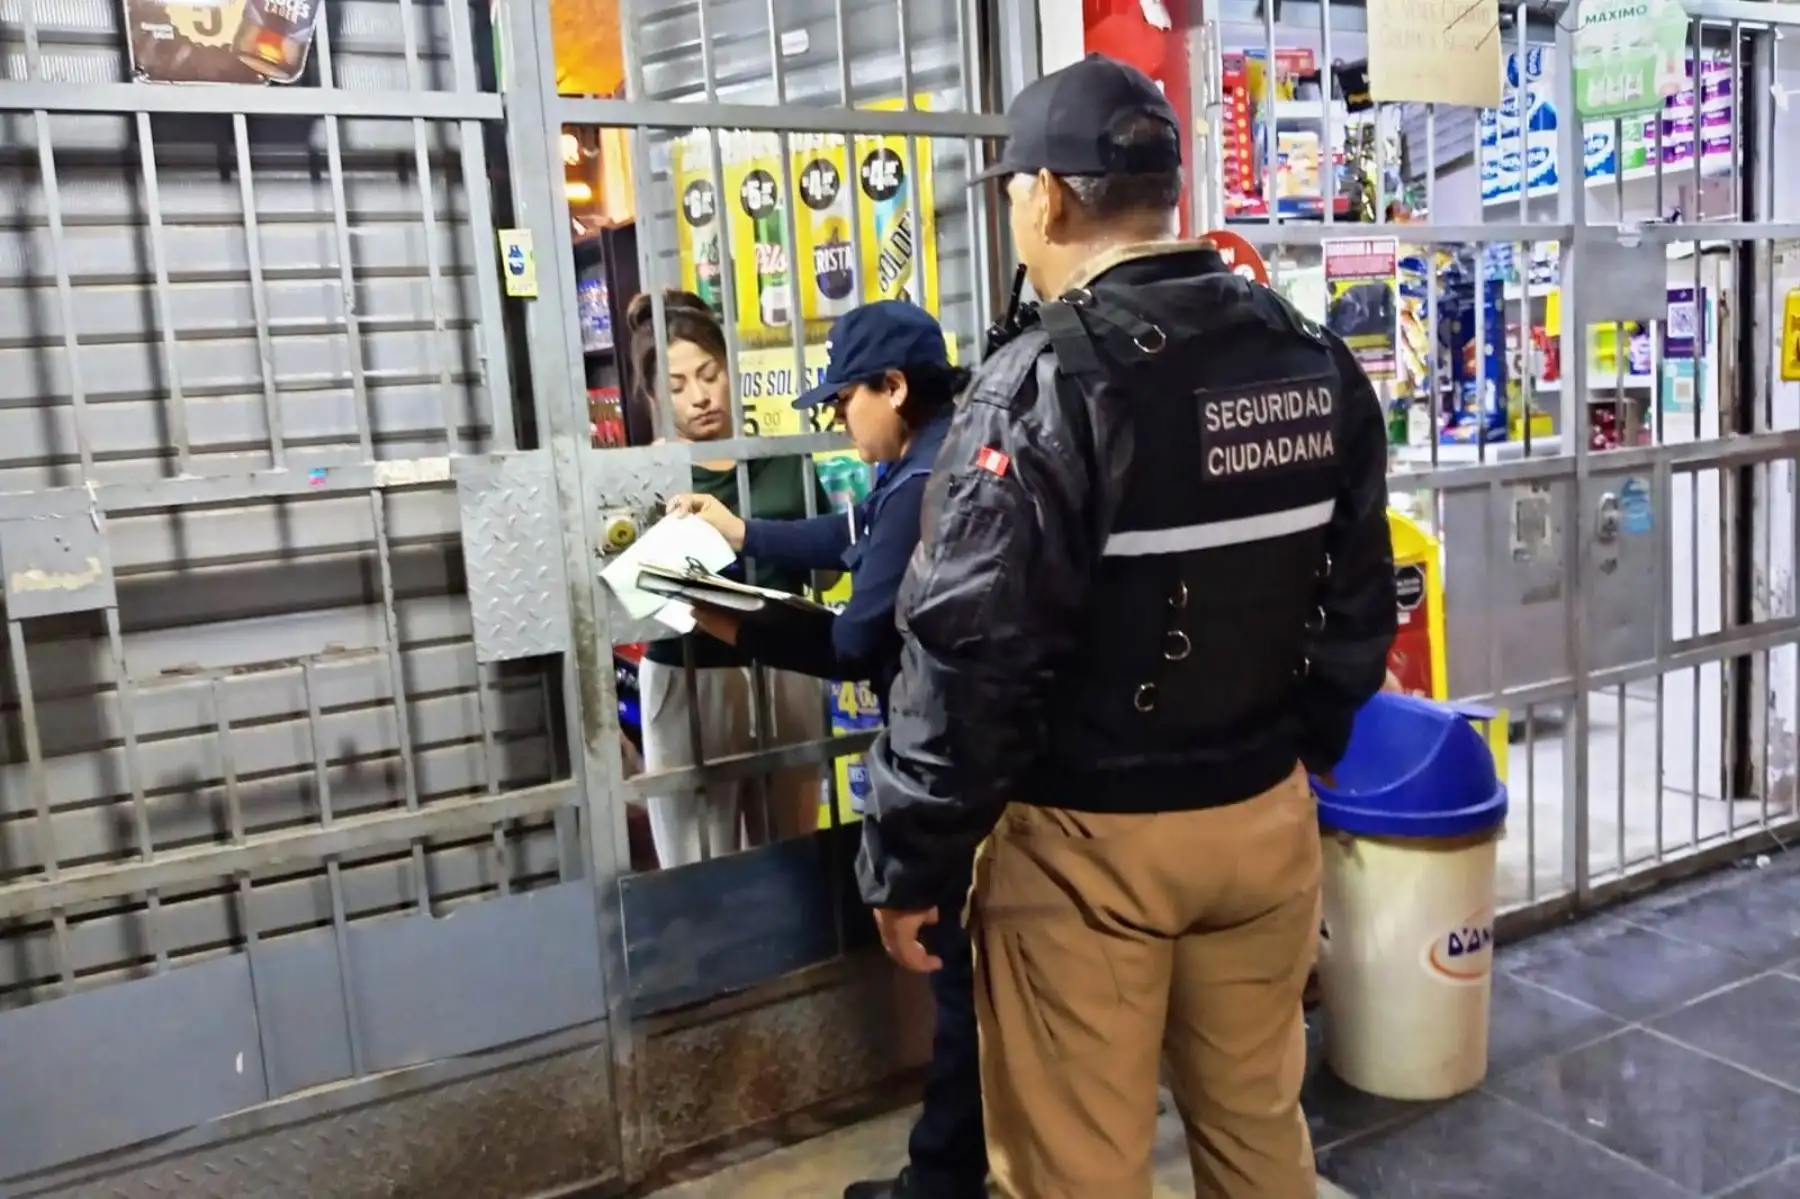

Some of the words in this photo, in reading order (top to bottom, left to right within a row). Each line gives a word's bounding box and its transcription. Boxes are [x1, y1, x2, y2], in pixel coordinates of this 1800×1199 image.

[1585, 4, 1648, 25] MAXIMO
[1204, 387, 1333, 432] SEGURIDAD
[1207, 431, 1335, 476] CIUDADANA
